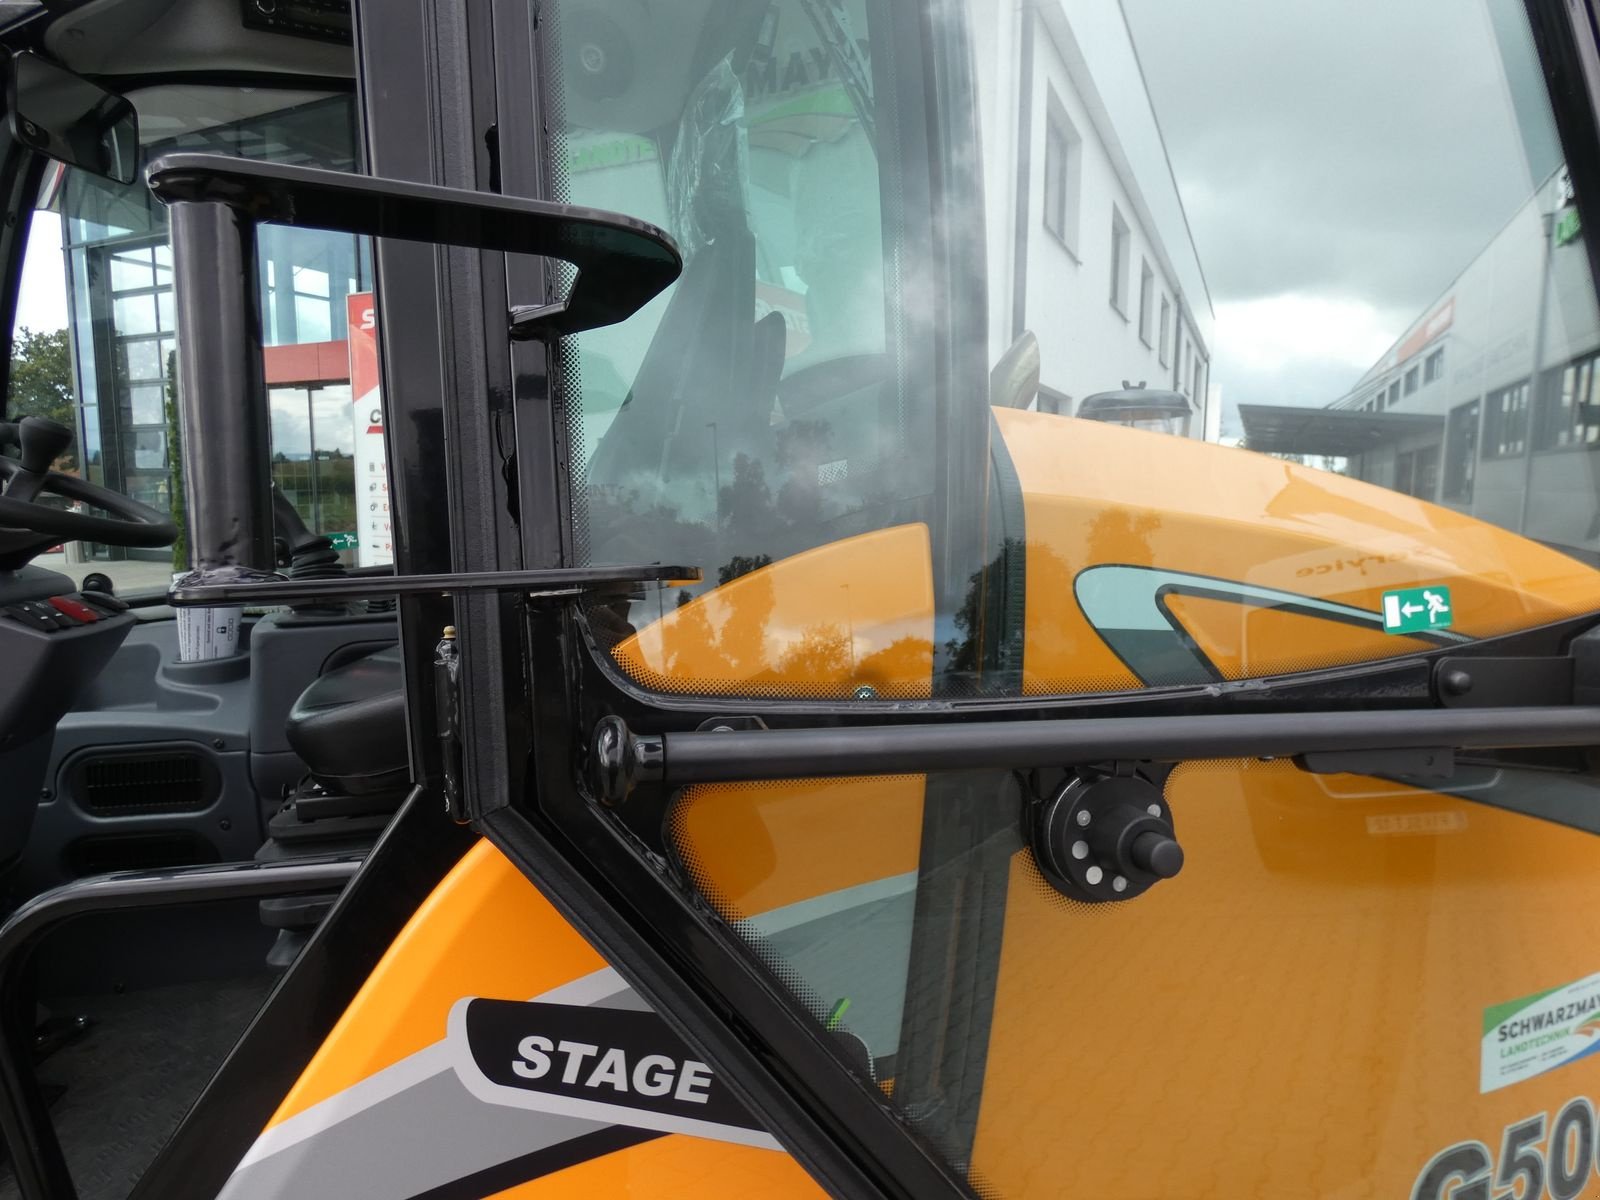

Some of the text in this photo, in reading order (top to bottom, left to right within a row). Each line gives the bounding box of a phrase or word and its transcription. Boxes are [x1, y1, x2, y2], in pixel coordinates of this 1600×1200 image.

[512, 1035, 714, 1104] STAGE
[1499, 1027, 1570, 1058] LANDTECHNIK
[1410, 1095, 1600, 1200] G50
